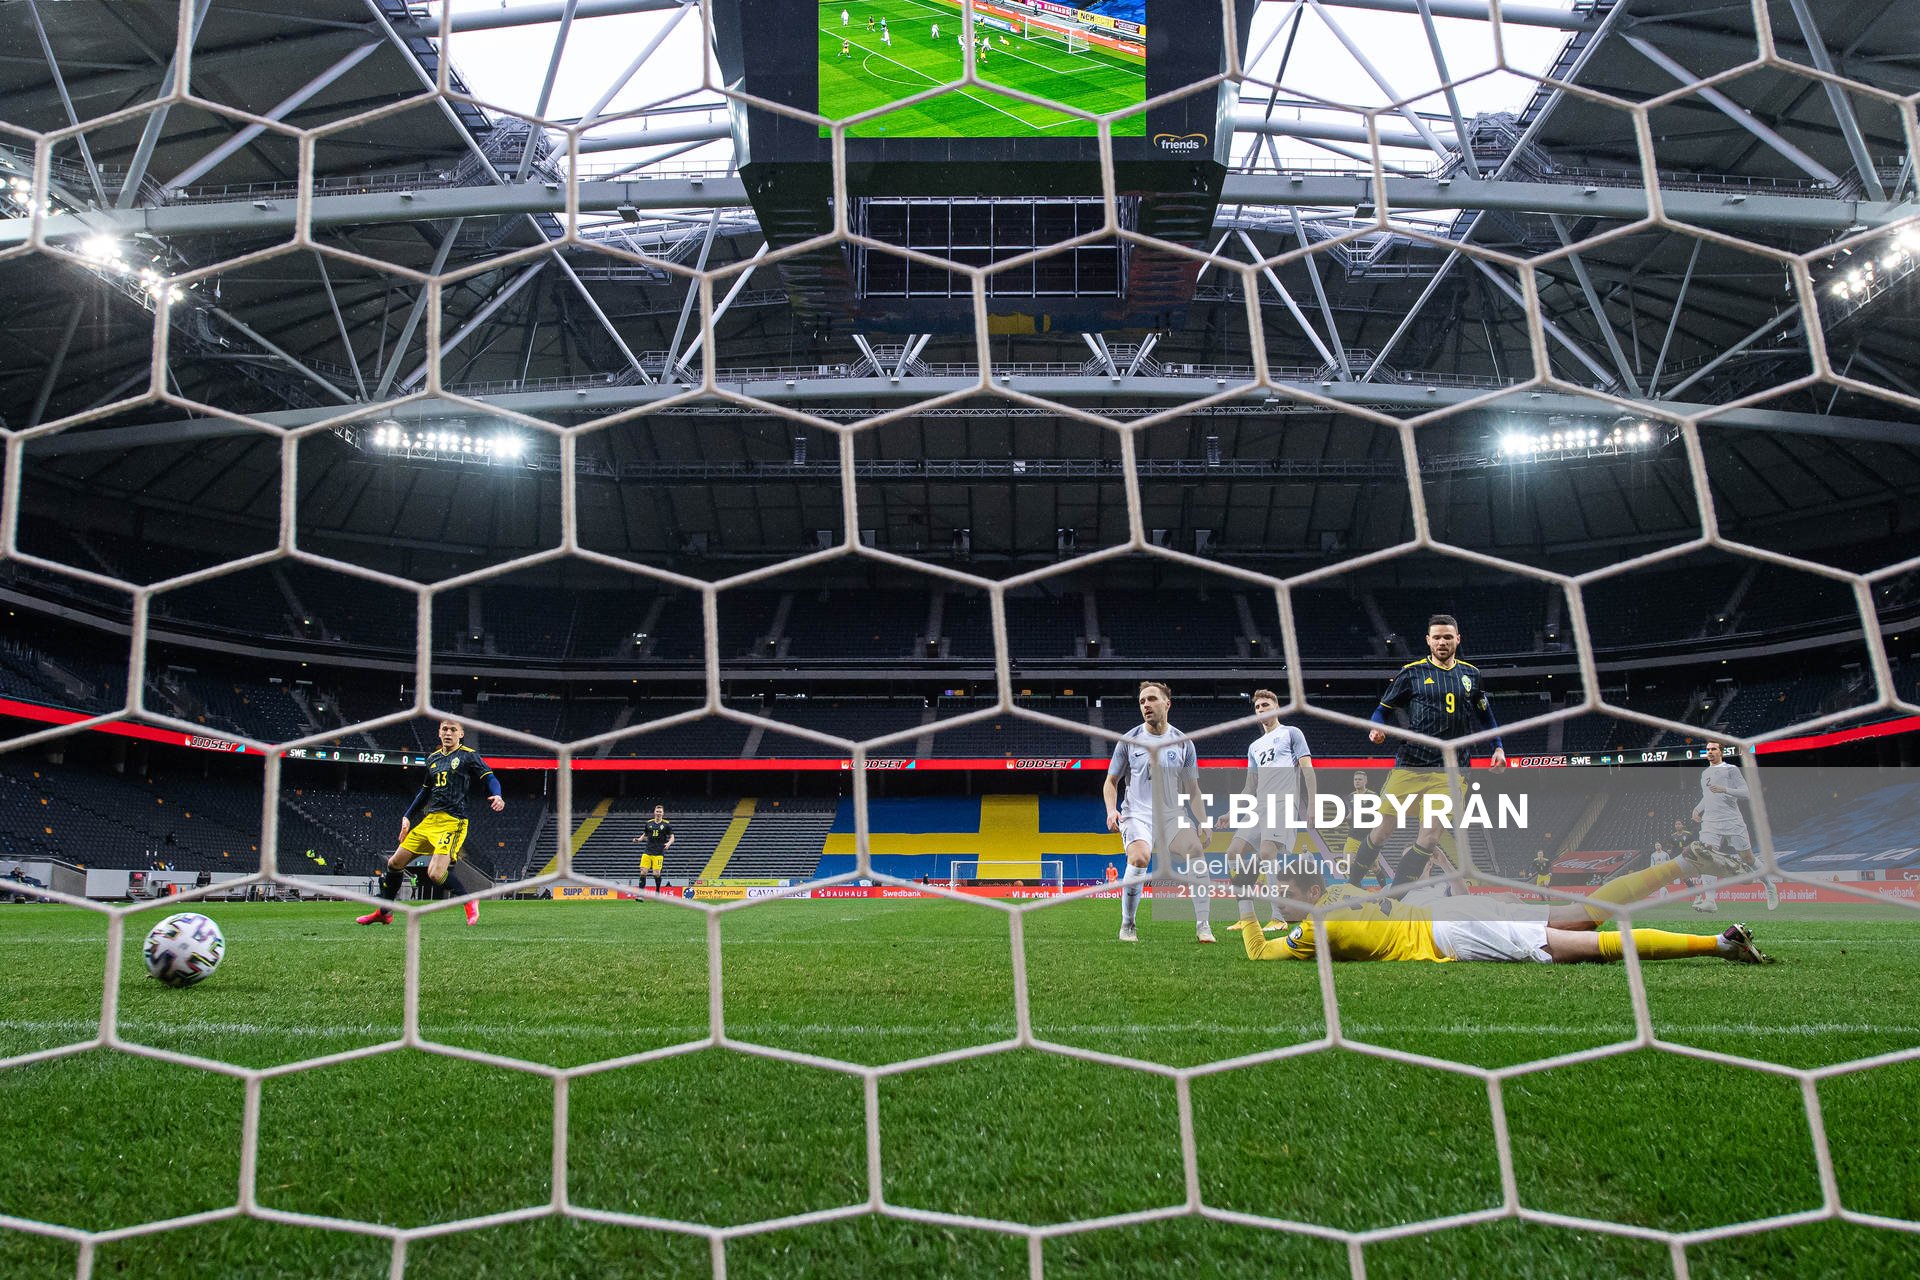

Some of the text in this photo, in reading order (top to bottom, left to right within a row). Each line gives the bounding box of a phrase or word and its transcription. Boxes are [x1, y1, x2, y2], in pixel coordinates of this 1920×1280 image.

[1161, 138, 1199, 149] friends
[1445, 692, 1455, 713] 9
[290, 748, 409, 765] SWE 0 02:57 0
[1259, 747, 1275, 765] 23
[1571, 756, 1591, 765] SWE
[1618, 754, 1624, 763] 0
[1642, 752, 1668, 762] 02:57
[1686, 750, 1692, 759] 0
[1015, 759, 1071, 769] ODDSET
[435, 771, 448, 787] 13
[883, 889, 921, 897] Swedbank
[1879, 887, 1914, 898] Swedbank
